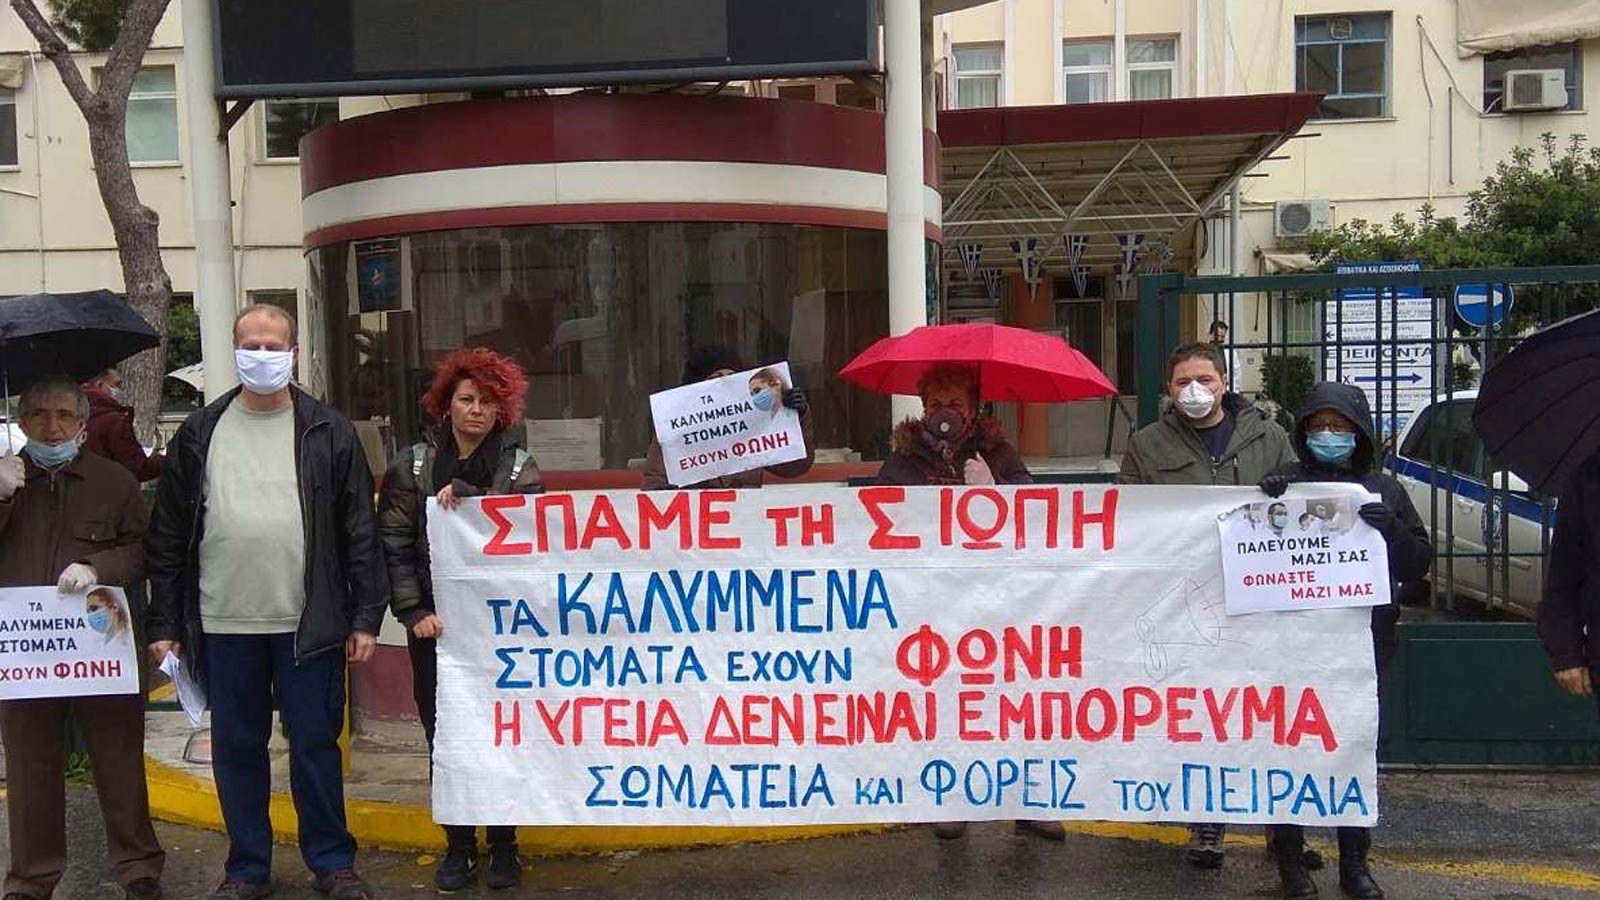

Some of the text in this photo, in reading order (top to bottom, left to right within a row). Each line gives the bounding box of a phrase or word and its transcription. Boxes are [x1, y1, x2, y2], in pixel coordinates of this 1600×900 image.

[700, 395, 714, 404] ΤΑ
[670, 401, 753, 430] ΚΑΛΥΜΜΕΝΑ
[682, 420, 748, 445] ΣΤΟΜΑΤΑ
[679, 431, 789, 470] ΕΧΟΥΝ ΦΩΝΗ
[481, 489, 741, 555] ΣΠΑΜΕ
[1237, 536, 1330, 555] ΠΑΛΕΥΟΥΜΕ
[1291, 549, 1369, 566] ΜΑΖΙ ΣΑΣ
[1243, 571, 1316, 587] ΦΩΝΑΞΤΕ
[1291, 583, 1374, 600] ΜΑΖΙ ΜΑΣ
[29, 602, 43, 612] ΤΑ
[487, 569, 898, 637] ΤΑ ΚΑΛΥΜΜΕΝΑ
[0, 618, 86, 632] ΑΛΥΜΜΕΝΑ
[0, 638, 77, 653] ΣΤΟΜΑΤΑ
[495, 625, 1082, 689] ΣΤΟΜΑΤΑ ΕΧΟΥΝ ΦΩΝΗ
[0, 660, 121, 681] ΧΟΥΝ ΦΩΝΗ
[495, 686, 1338, 752] Η ΥΓΕΙΑ ΔΕΝ ΕΙΝΑΙ ΕΜΠΟΡΕΥΜΑ
[585, 758, 1369, 817] ΣΩΜΑΤΕΙΑ ΚΑΙ ΦΟΡΕΙΣ ΤΟΥ ΠΕΙΡΑΙΑ
